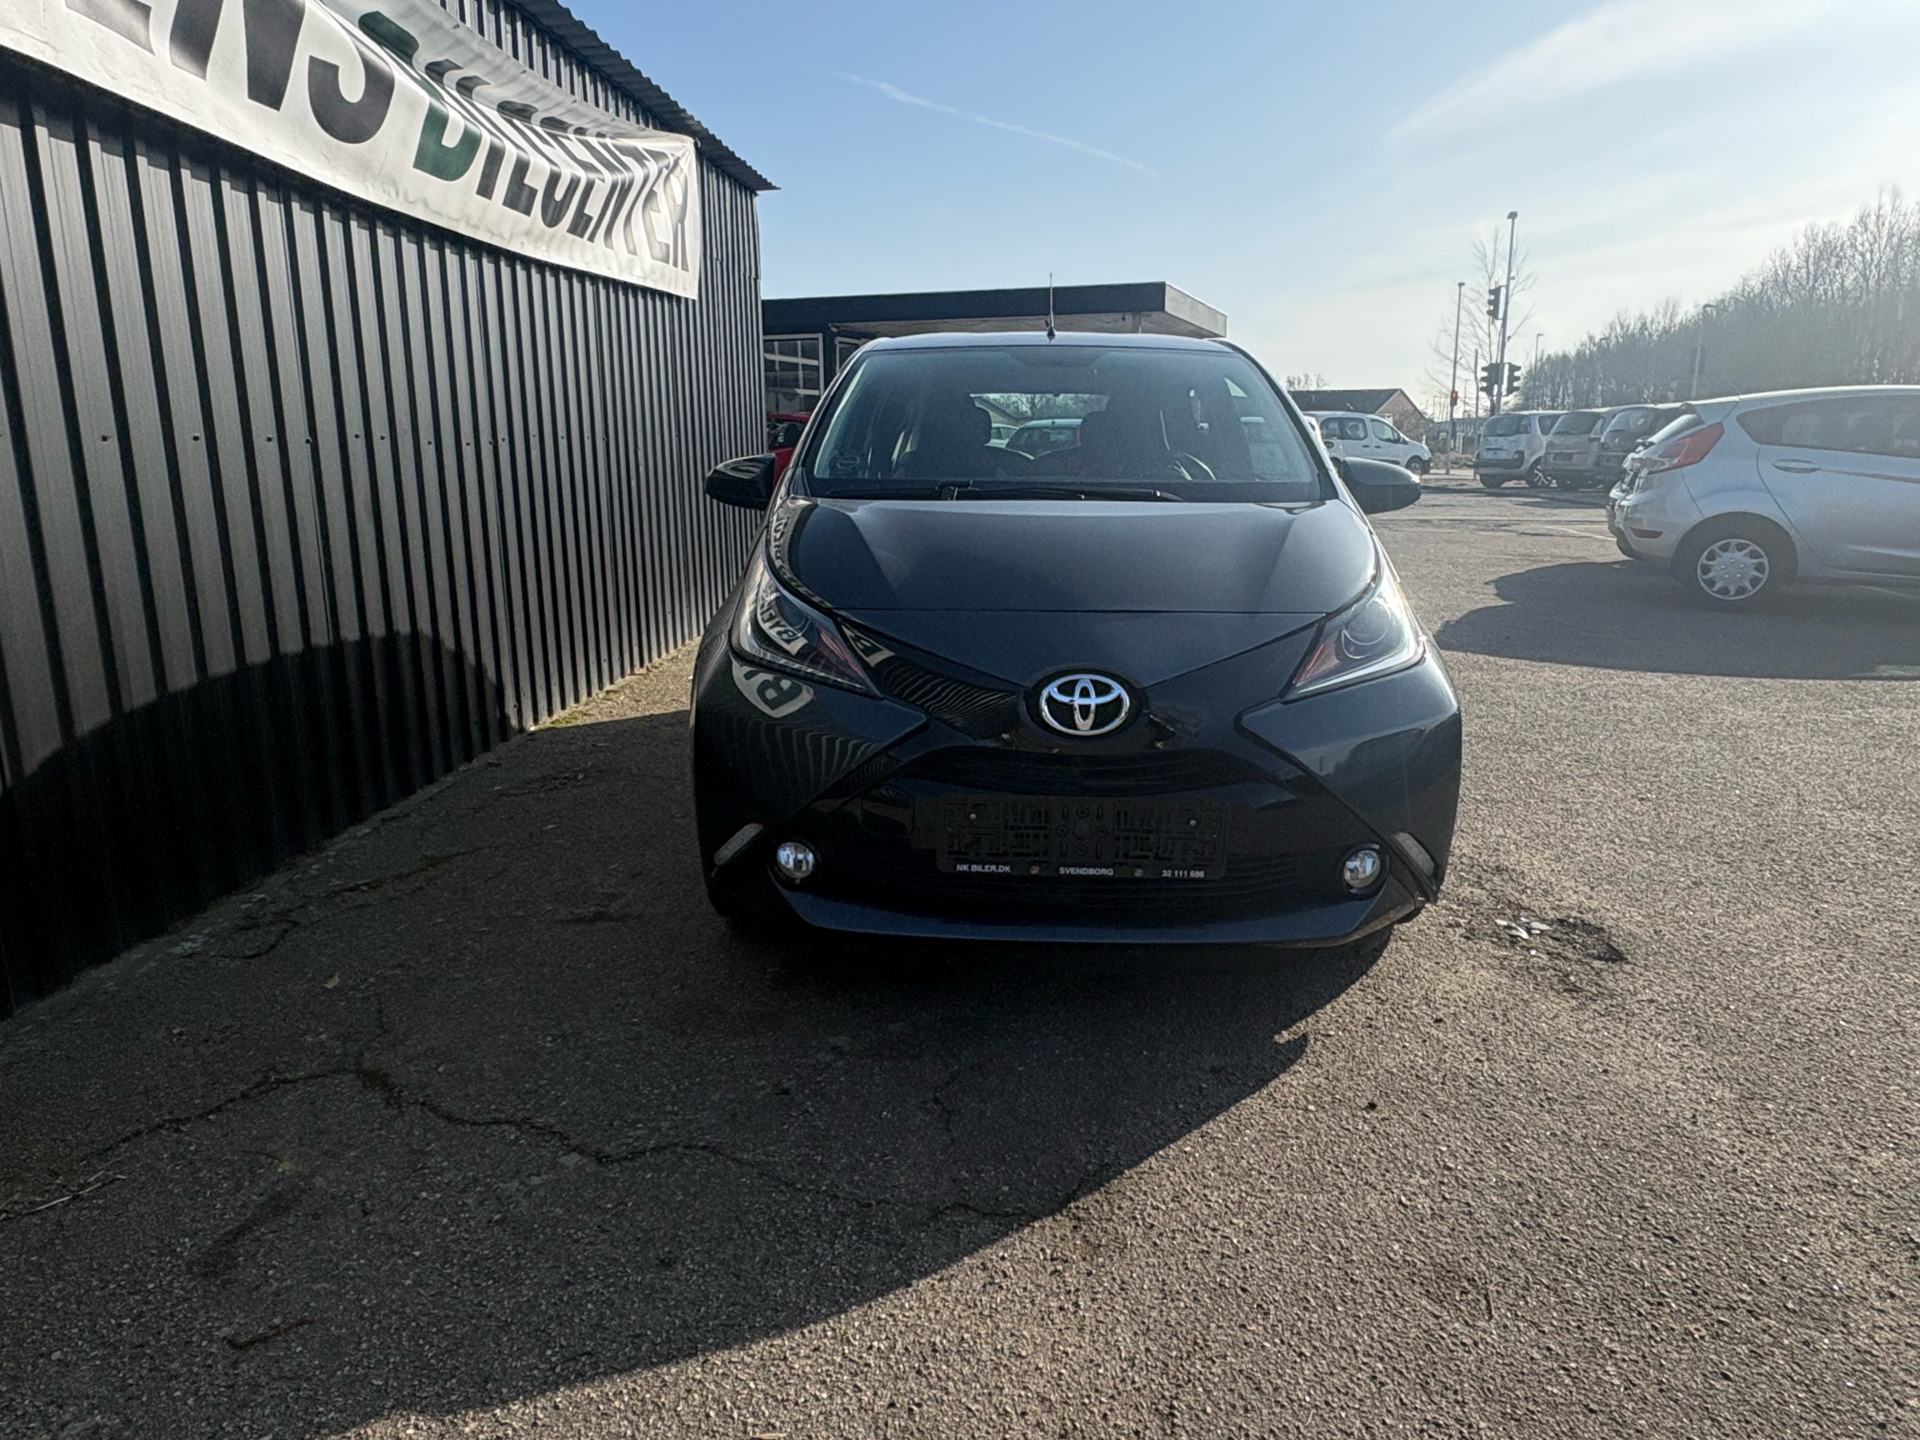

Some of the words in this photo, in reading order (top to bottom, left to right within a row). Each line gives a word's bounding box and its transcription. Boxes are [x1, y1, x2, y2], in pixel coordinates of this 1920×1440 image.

[1059, 867, 1114, 876] SVENDBORG
[1161, 869, 1172, 877] 32
[1174, 869, 1188, 878] 111
